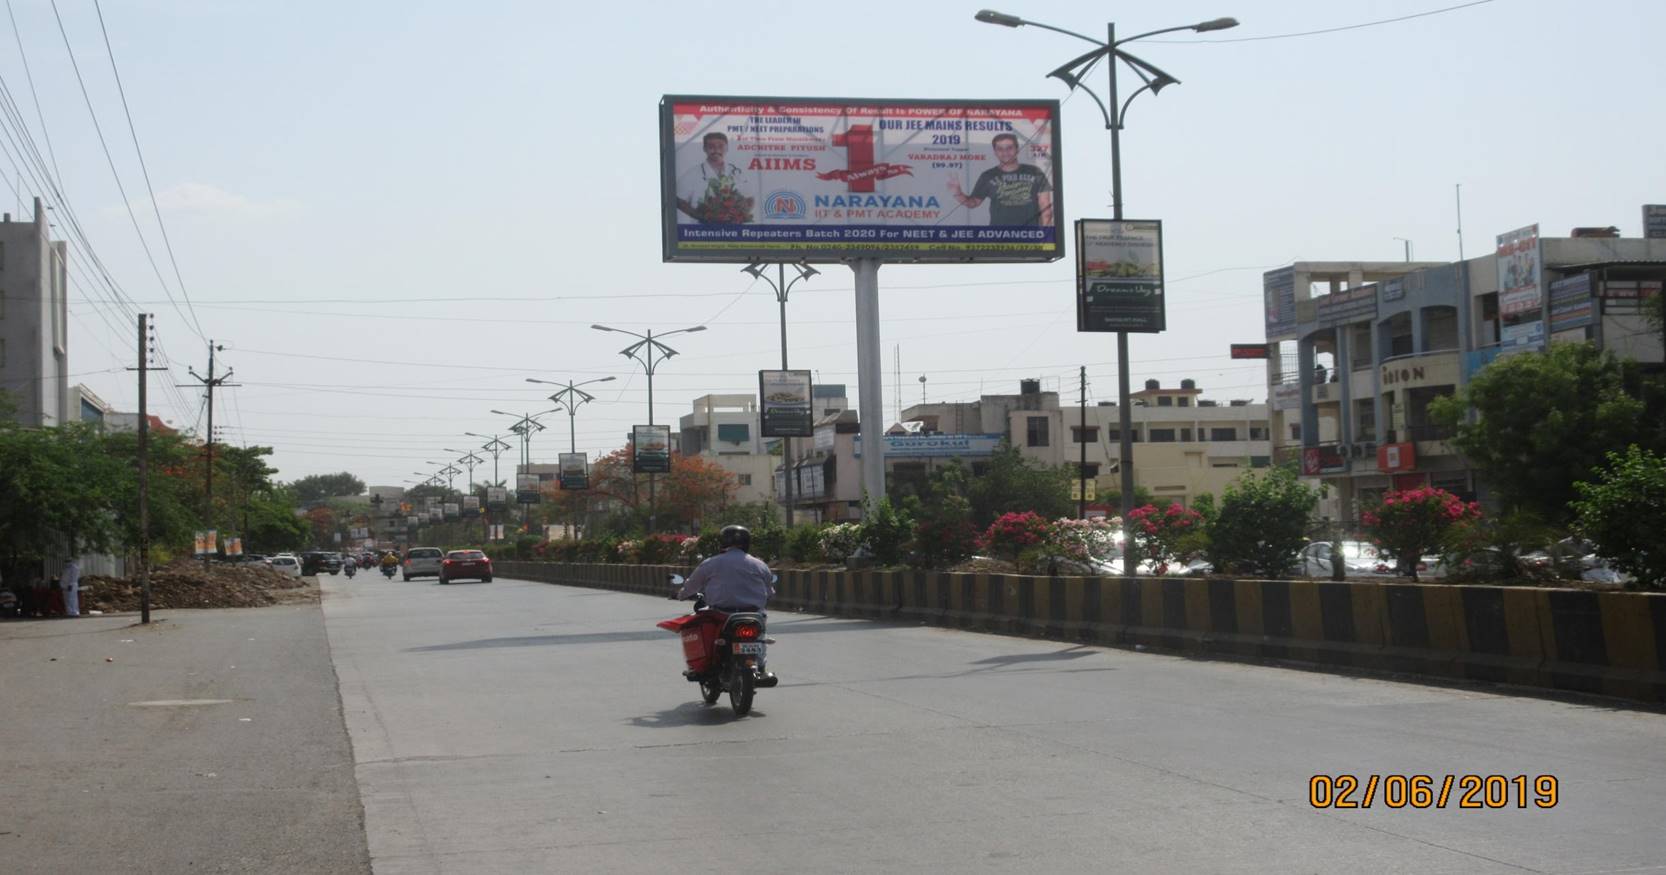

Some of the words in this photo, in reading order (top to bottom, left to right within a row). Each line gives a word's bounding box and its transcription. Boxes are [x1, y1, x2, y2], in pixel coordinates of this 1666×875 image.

[699, 105, 765, 114] Authenticity
[779, 106, 842, 115] Consistency
[750, 125, 768, 133] NEET
[879, 119, 904, 130] OUR
[905, 120, 922, 130] JEE
[925, 120, 962, 131] MAINS
[966, 120, 1013, 131] RESULTS
[932, 134, 961, 145] 2019
[748, 157, 817, 171] AIIMS
[814, 194, 941, 208] NARAYANA
[834, 209, 842, 218] &
[847, 209, 872, 219] PMT
[877, 209, 941, 219] ACADEMY
[684, 228, 738, 237] Intensive
[742, 228, 801, 239] Repeaters
[805, 229, 840, 238] Batch
[844, 229, 876, 238] 2020
[880, 229, 899, 238] For
[903, 229, 936, 238] NEET
[938, 230, 948, 238] &
[951, 229, 974, 239] JEE
[977, 230, 1045, 239] ADVANCED
